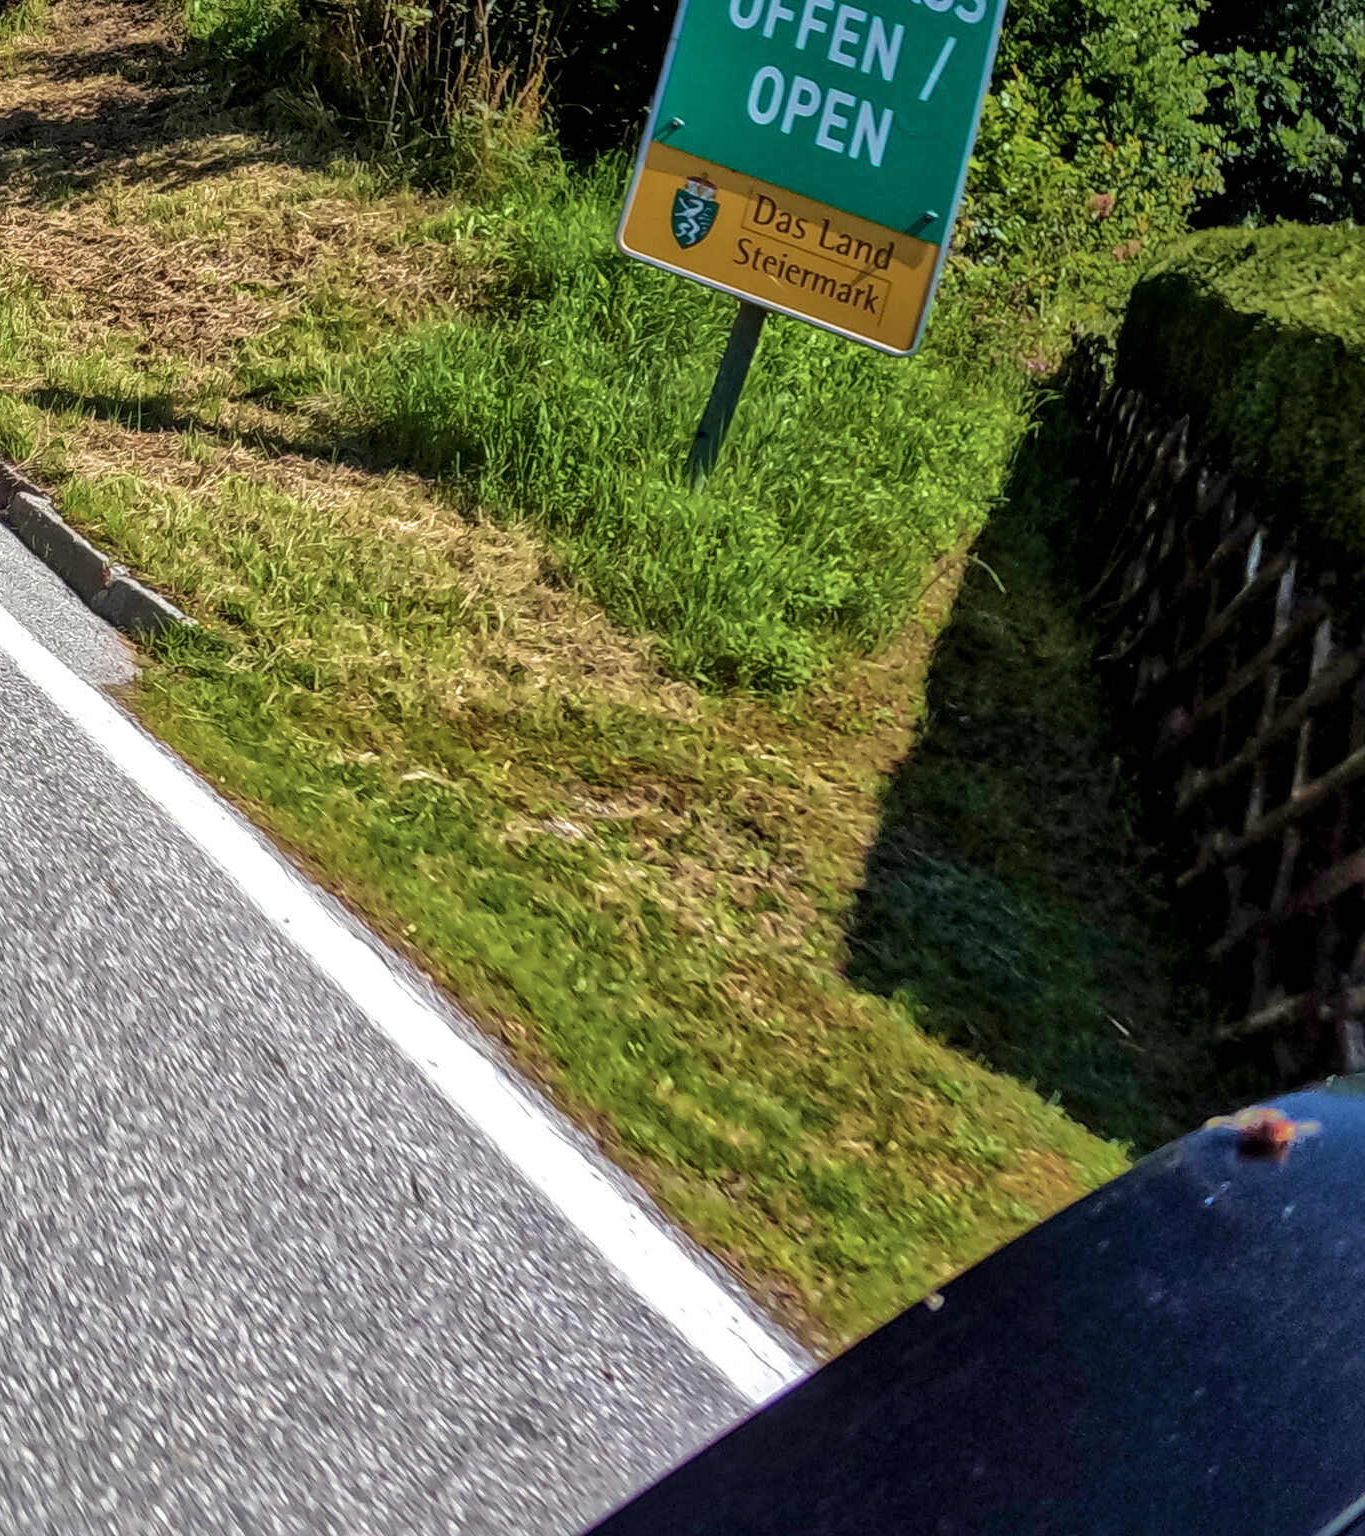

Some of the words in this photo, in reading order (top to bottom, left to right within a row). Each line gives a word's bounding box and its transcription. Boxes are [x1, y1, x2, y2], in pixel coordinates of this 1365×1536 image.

[747, 65, 894, 167] OPEN
[753, 195, 807, 239] Das
[819, 219, 895, 270] Land
[733, 238, 880, 314] Steiermark
